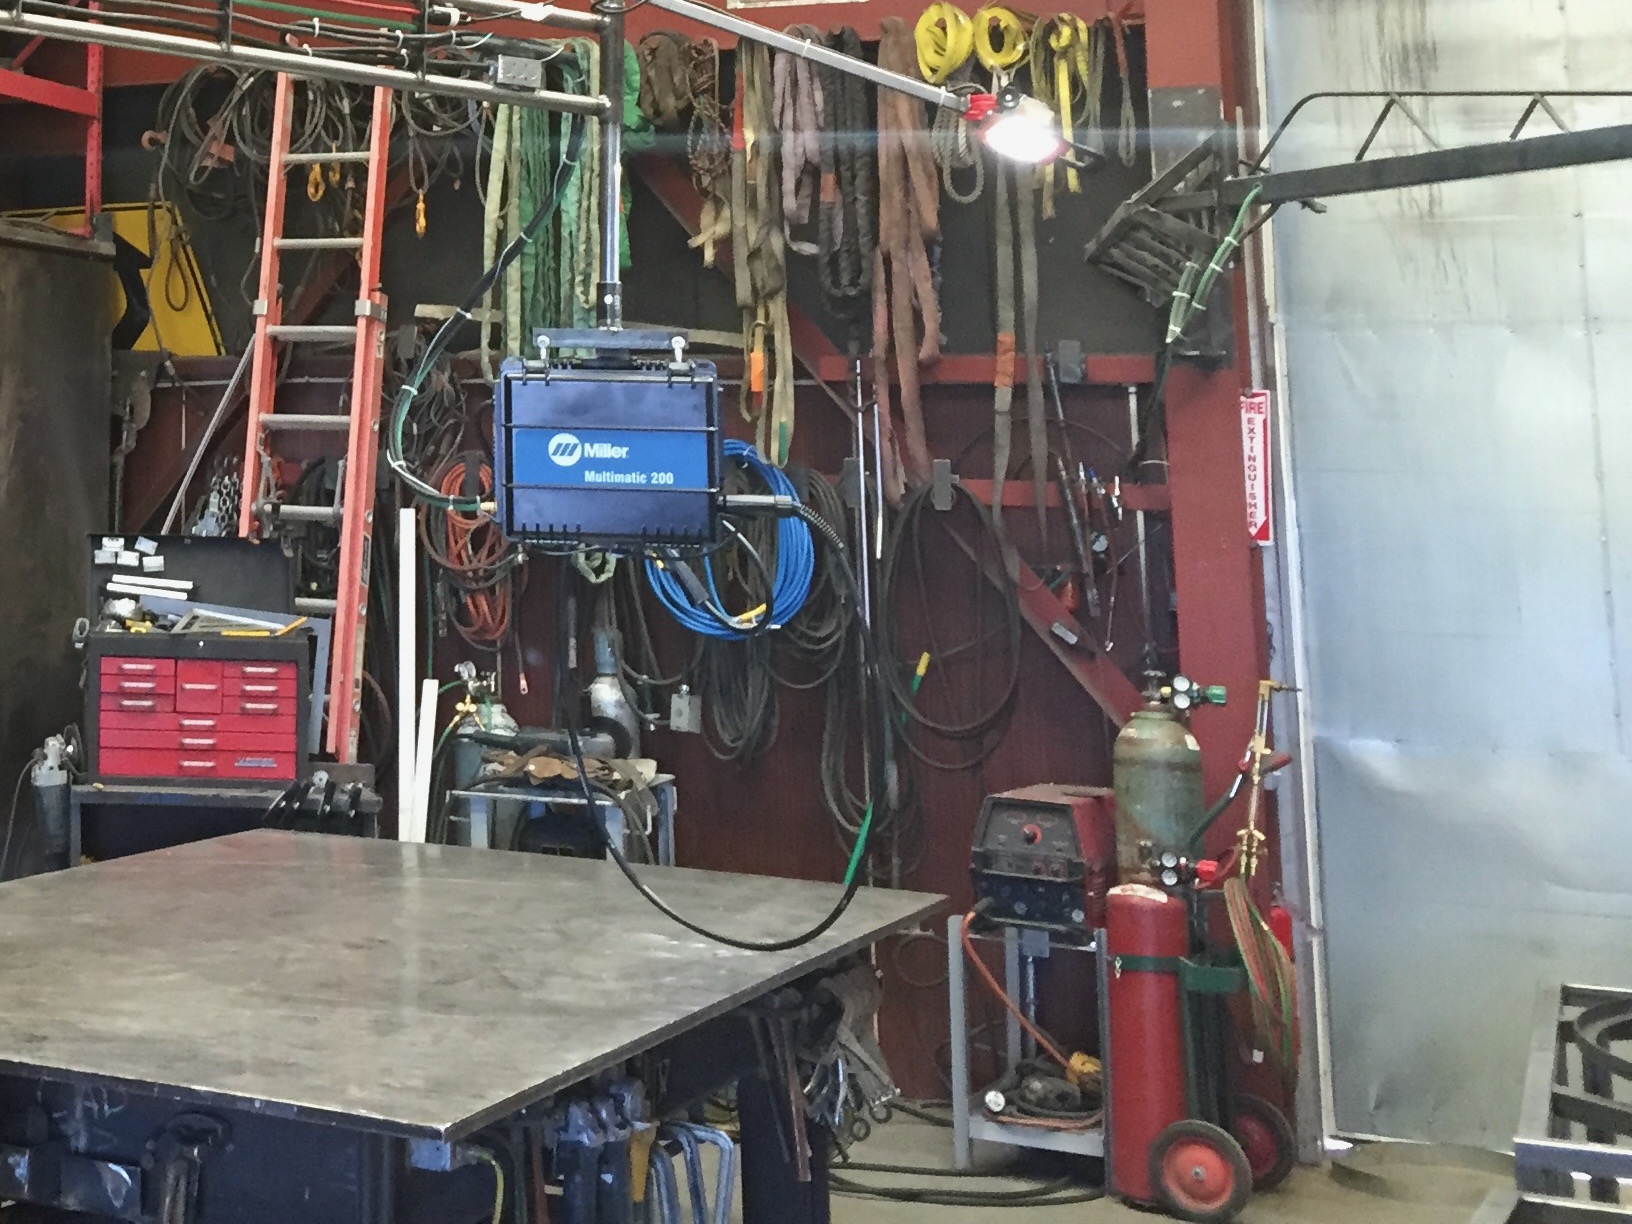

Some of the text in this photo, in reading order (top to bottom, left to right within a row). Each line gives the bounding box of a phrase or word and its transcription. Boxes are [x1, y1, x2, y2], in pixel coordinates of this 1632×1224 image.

[585, 442, 630, 459] Miller
[584, 470, 674, 485] Multimatic 200
[1246, 417, 1258, 528] EXTINGUISHER
